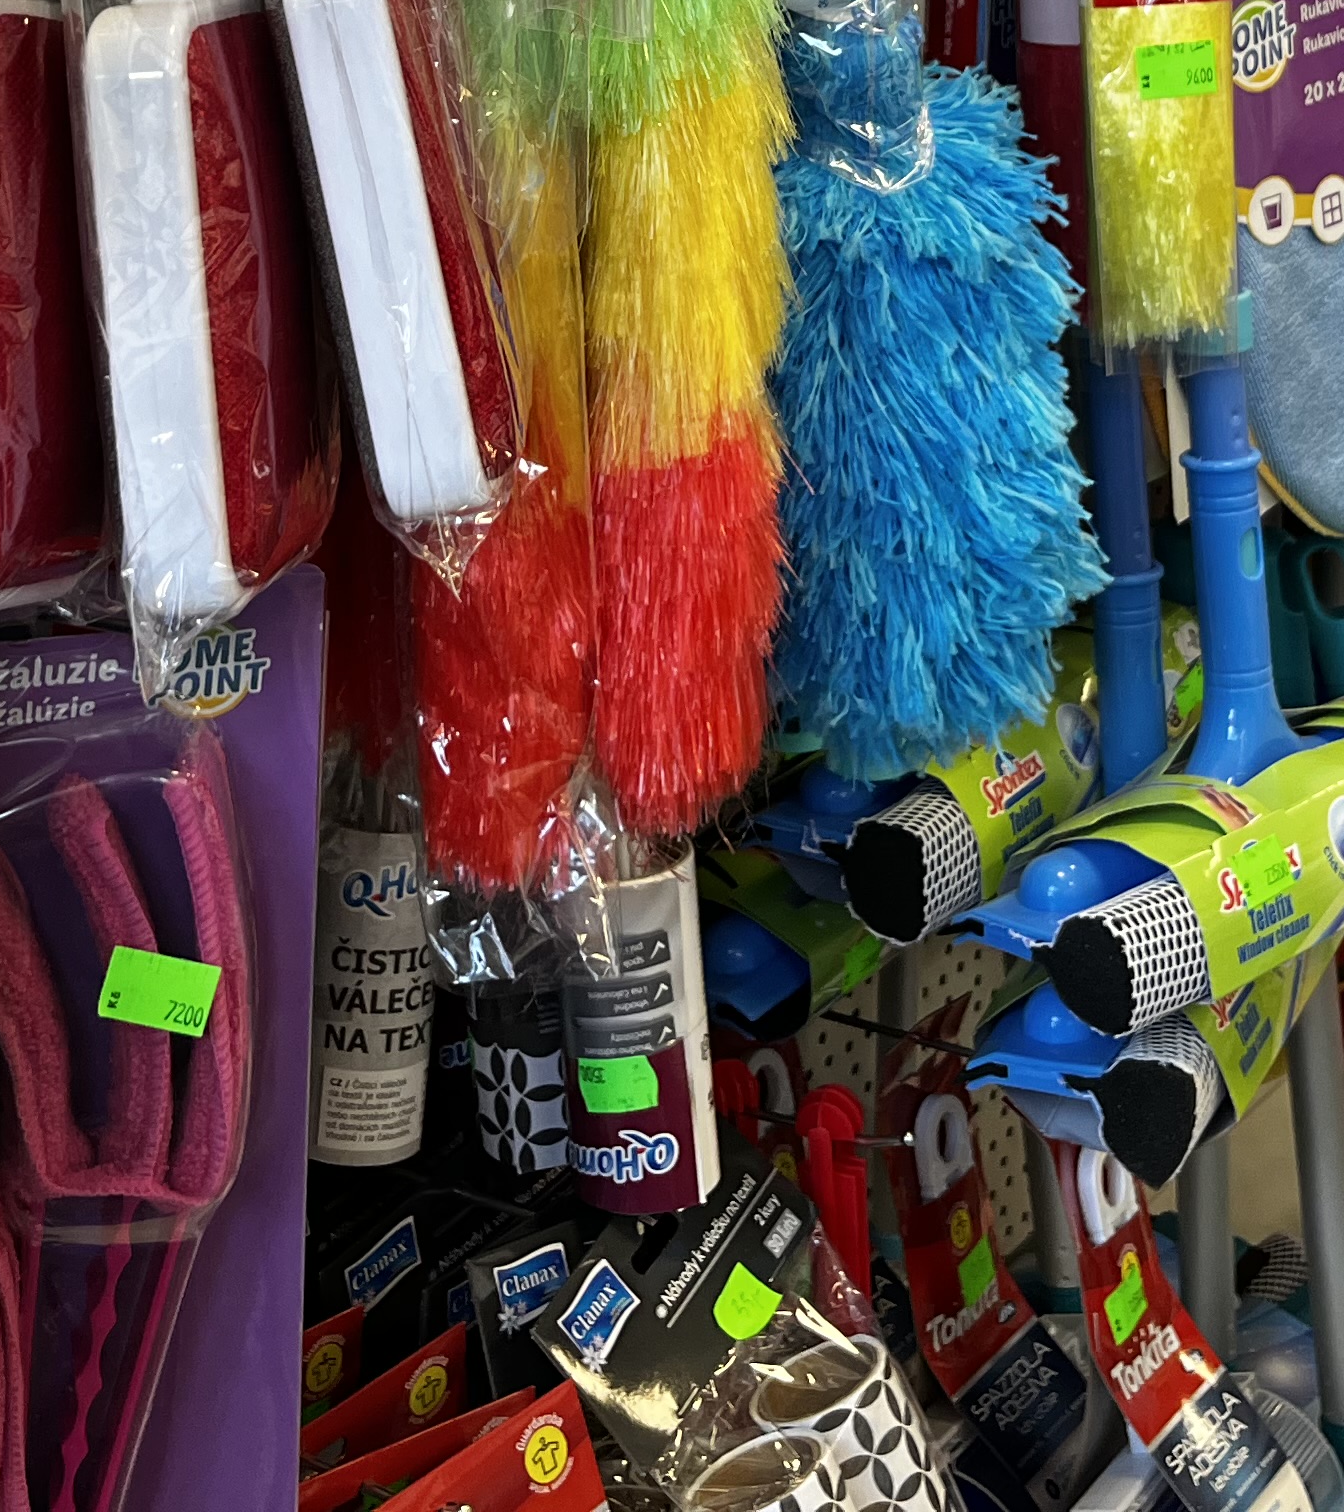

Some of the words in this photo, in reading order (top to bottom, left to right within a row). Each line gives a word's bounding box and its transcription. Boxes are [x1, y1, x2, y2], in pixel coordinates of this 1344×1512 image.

[1232, 3, 1286, 53] OME
[1304, 79, 1324, 106] 20
[1237, 938, 1274, 964] Window
[1275, 914, 1311, 945] cleaner
[1247, 894, 1295, 935] Telefix
[324, 1024, 369, 1053] NA
[351, 1242, 408, 1291] Clanax
[502, 1264, 560, 1297] Clanax
[570, 1284, 617, 1340] Clanax
[971, 1341, 1053, 1423] SPAZZOLA
[1110, 1324, 1180, 1400] Tonkita
